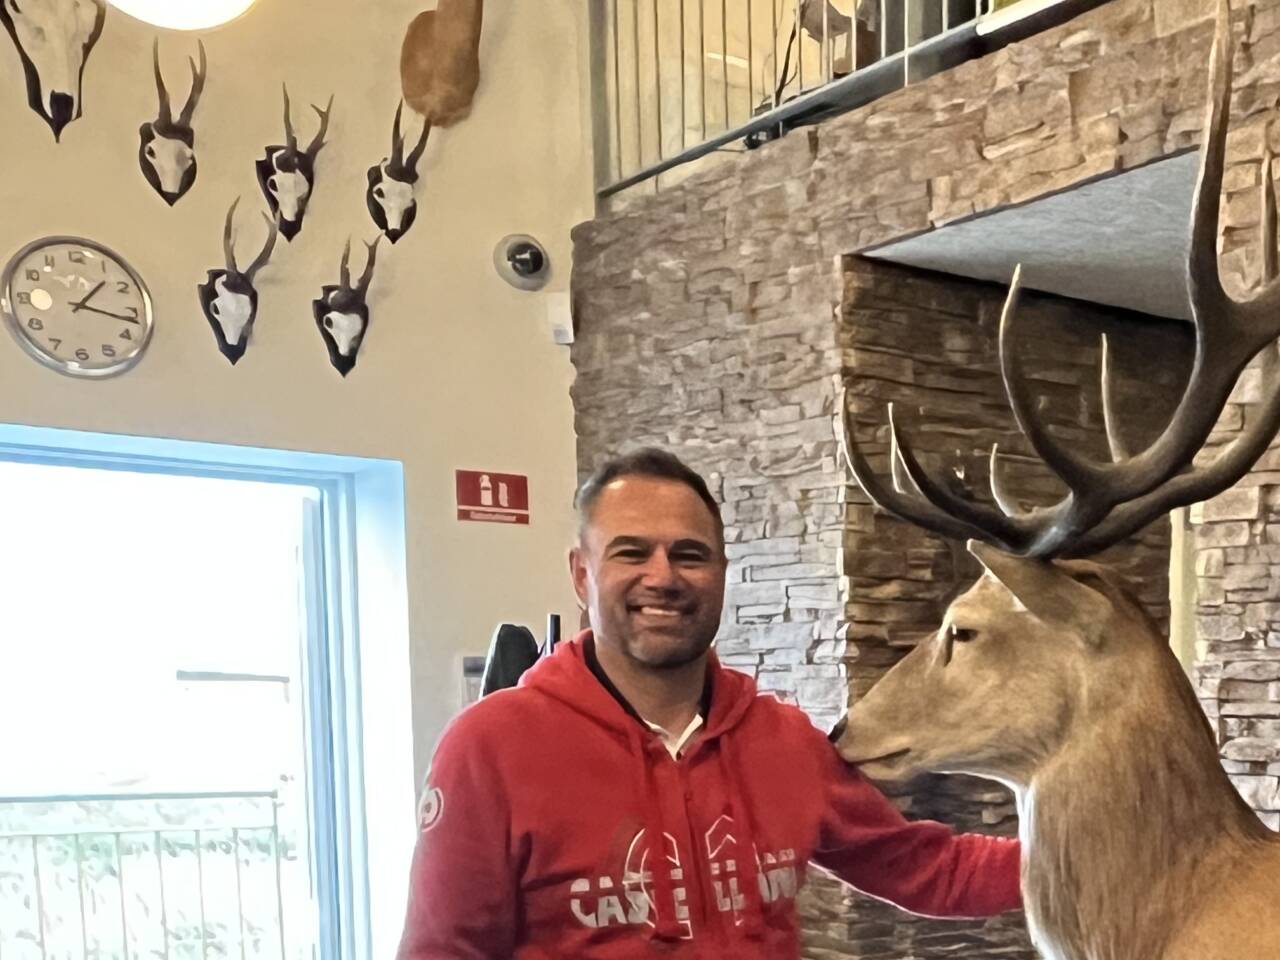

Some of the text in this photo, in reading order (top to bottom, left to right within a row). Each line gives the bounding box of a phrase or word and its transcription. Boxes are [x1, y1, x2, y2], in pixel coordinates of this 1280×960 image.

[25, 269, 40, 281] 10
[116, 281, 130, 294] 2
[28, 318, 43, 330] 8
[119, 328, 132, 340] 4
[48, 338, 62, 350] 7
[75, 348, 89, 361] 6
[101, 344, 116, 357] 5
